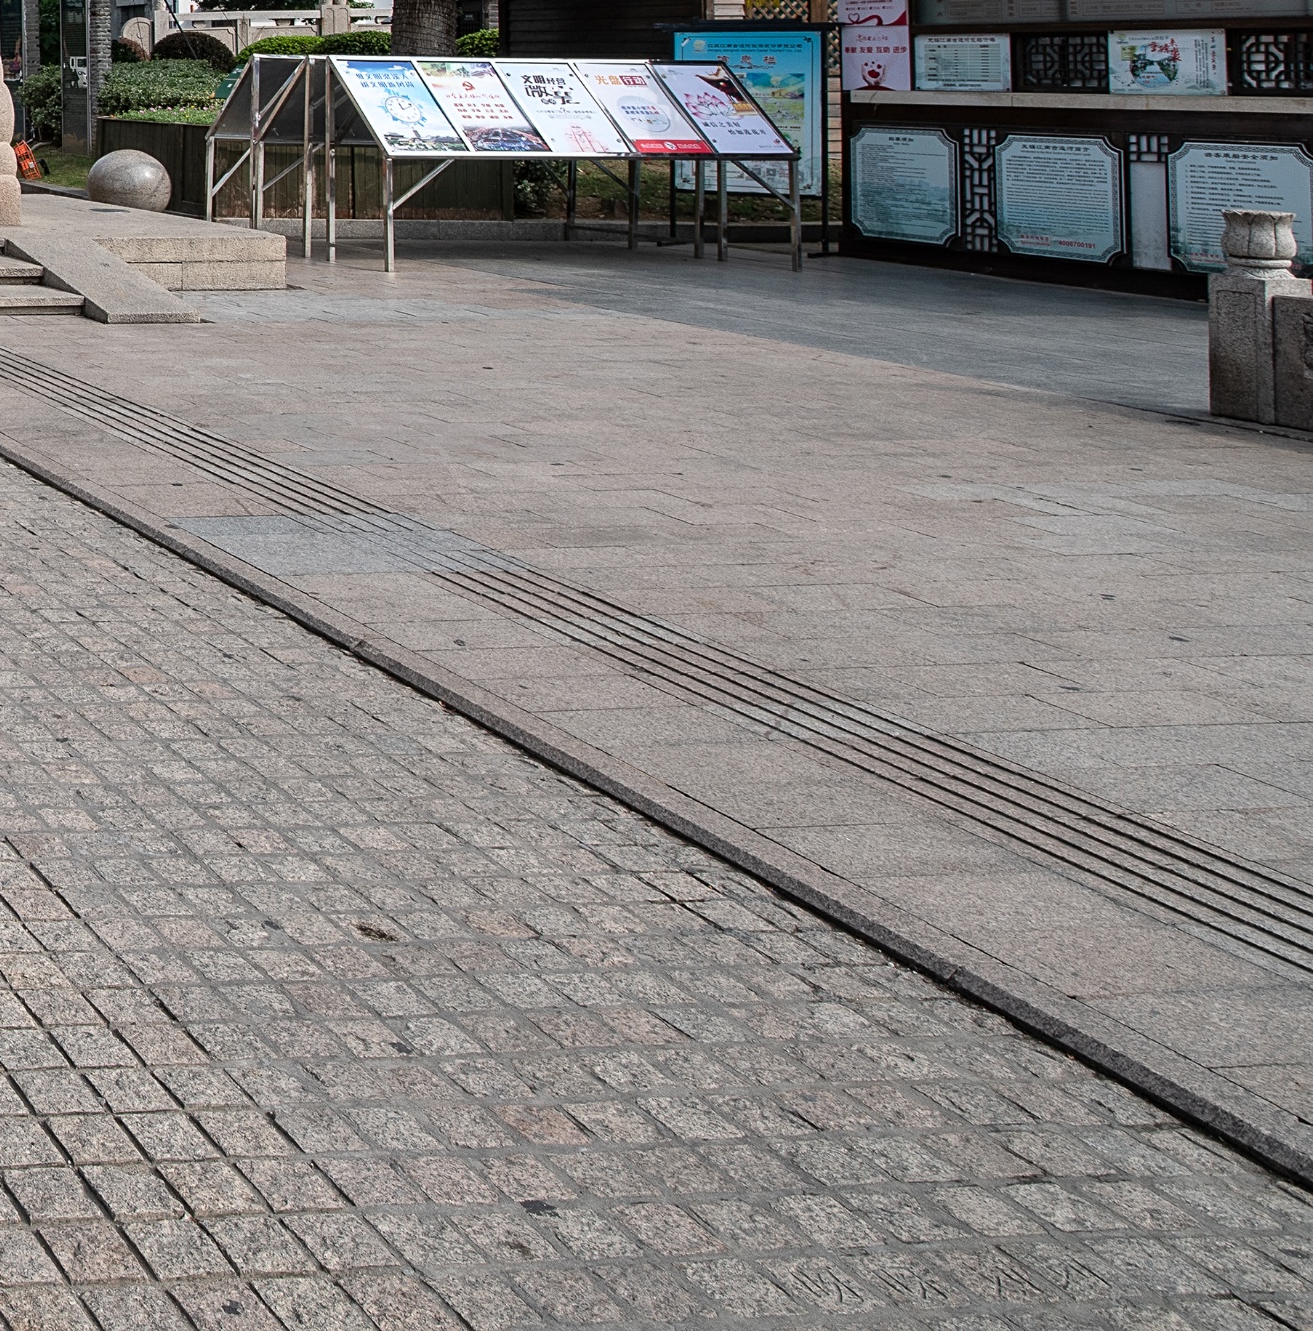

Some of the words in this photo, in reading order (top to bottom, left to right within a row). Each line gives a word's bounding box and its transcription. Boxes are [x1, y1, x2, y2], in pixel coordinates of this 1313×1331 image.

[844, 46, 857, 54] 奉献
[859, 46, 873, 54] 友爱
[876, 46, 890, 54] 互助
[893, 46, 907, 54] 进步
[595, 74, 648, 86] 光盘行动
[1058, 240, 1096, 249] 4008700191
